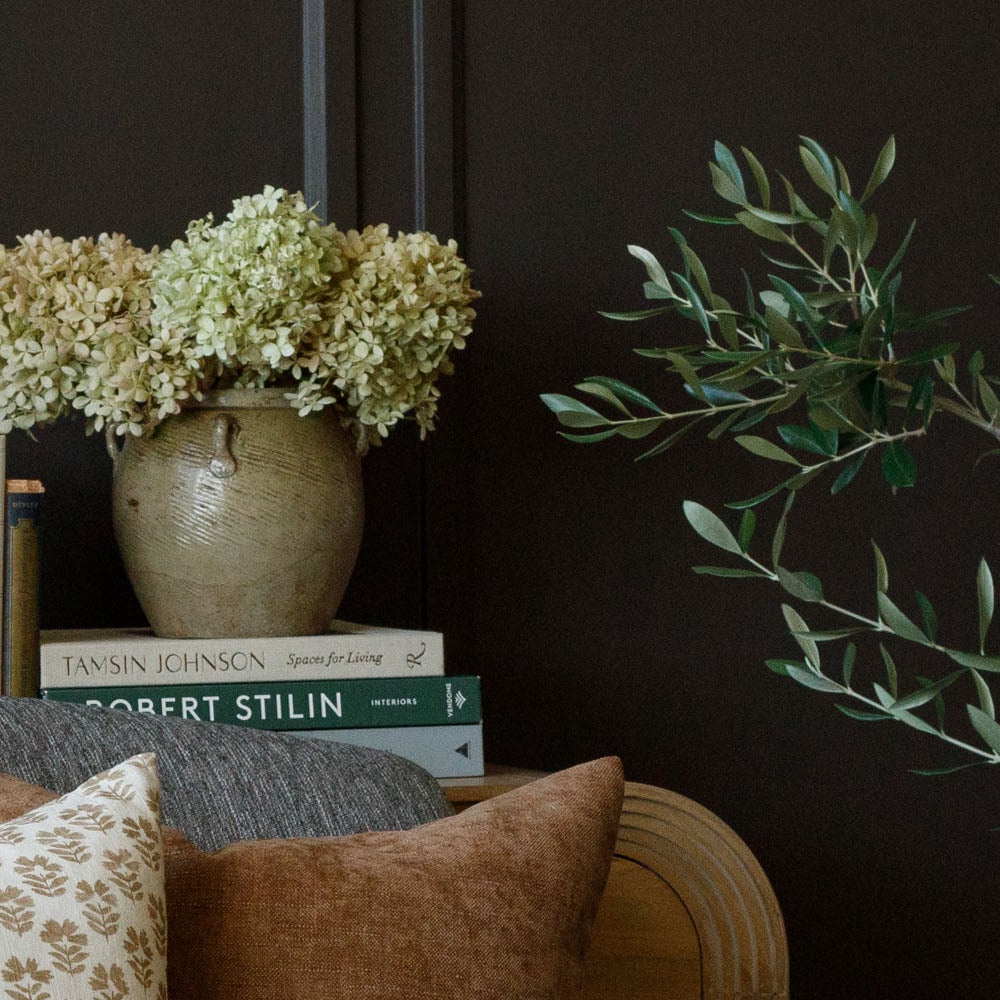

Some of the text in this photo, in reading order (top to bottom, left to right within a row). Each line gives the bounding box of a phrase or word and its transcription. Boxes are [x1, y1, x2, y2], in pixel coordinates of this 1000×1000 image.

[63, 650, 383, 677] TAMSIN JOHNSON Spaces for Living
[235, 691, 343, 721] STILIN
[370, 697, 417, 706] INTERIORS
[445, 683, 454, 718] VENDOME
